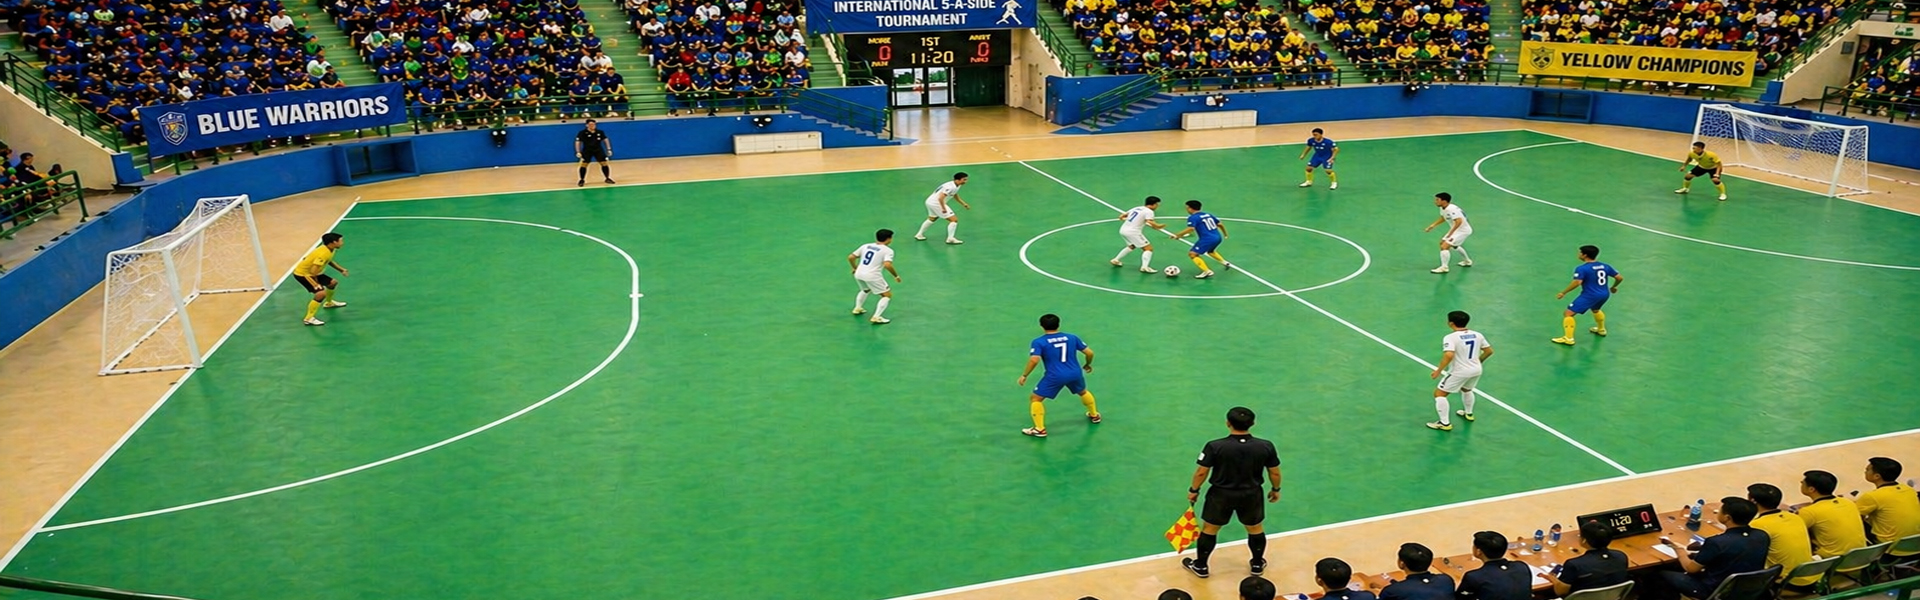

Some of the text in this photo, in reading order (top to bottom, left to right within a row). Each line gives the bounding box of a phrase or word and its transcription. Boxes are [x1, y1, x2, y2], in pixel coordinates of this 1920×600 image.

[834, 0, 996, 13] INTERNATIONAL 5-A-SIDE
[875, 13, 968, 28] TOURNAMENT
[920, 36, 940, 46] 1ST
[978, 41, 990, 57] 0
[879, 45, 891, 61] 0
[911, 51, 954, 64] 11:20
[1561, 52, 1746, 77] YELLOW CHAMPIONS
[197, 108, 260, 135] BLUE
[265, 95, 390, 126] WARRIORS
[1202, 217, 1217, 231] 10
[862, 250, 875, 266] 9
[1597, 269, 1606, 286] 8
[1053, 342, 1067, 363] 7
[1465, 340, 1475, 359] 7
[1640, 511, 1650, 523] 0
